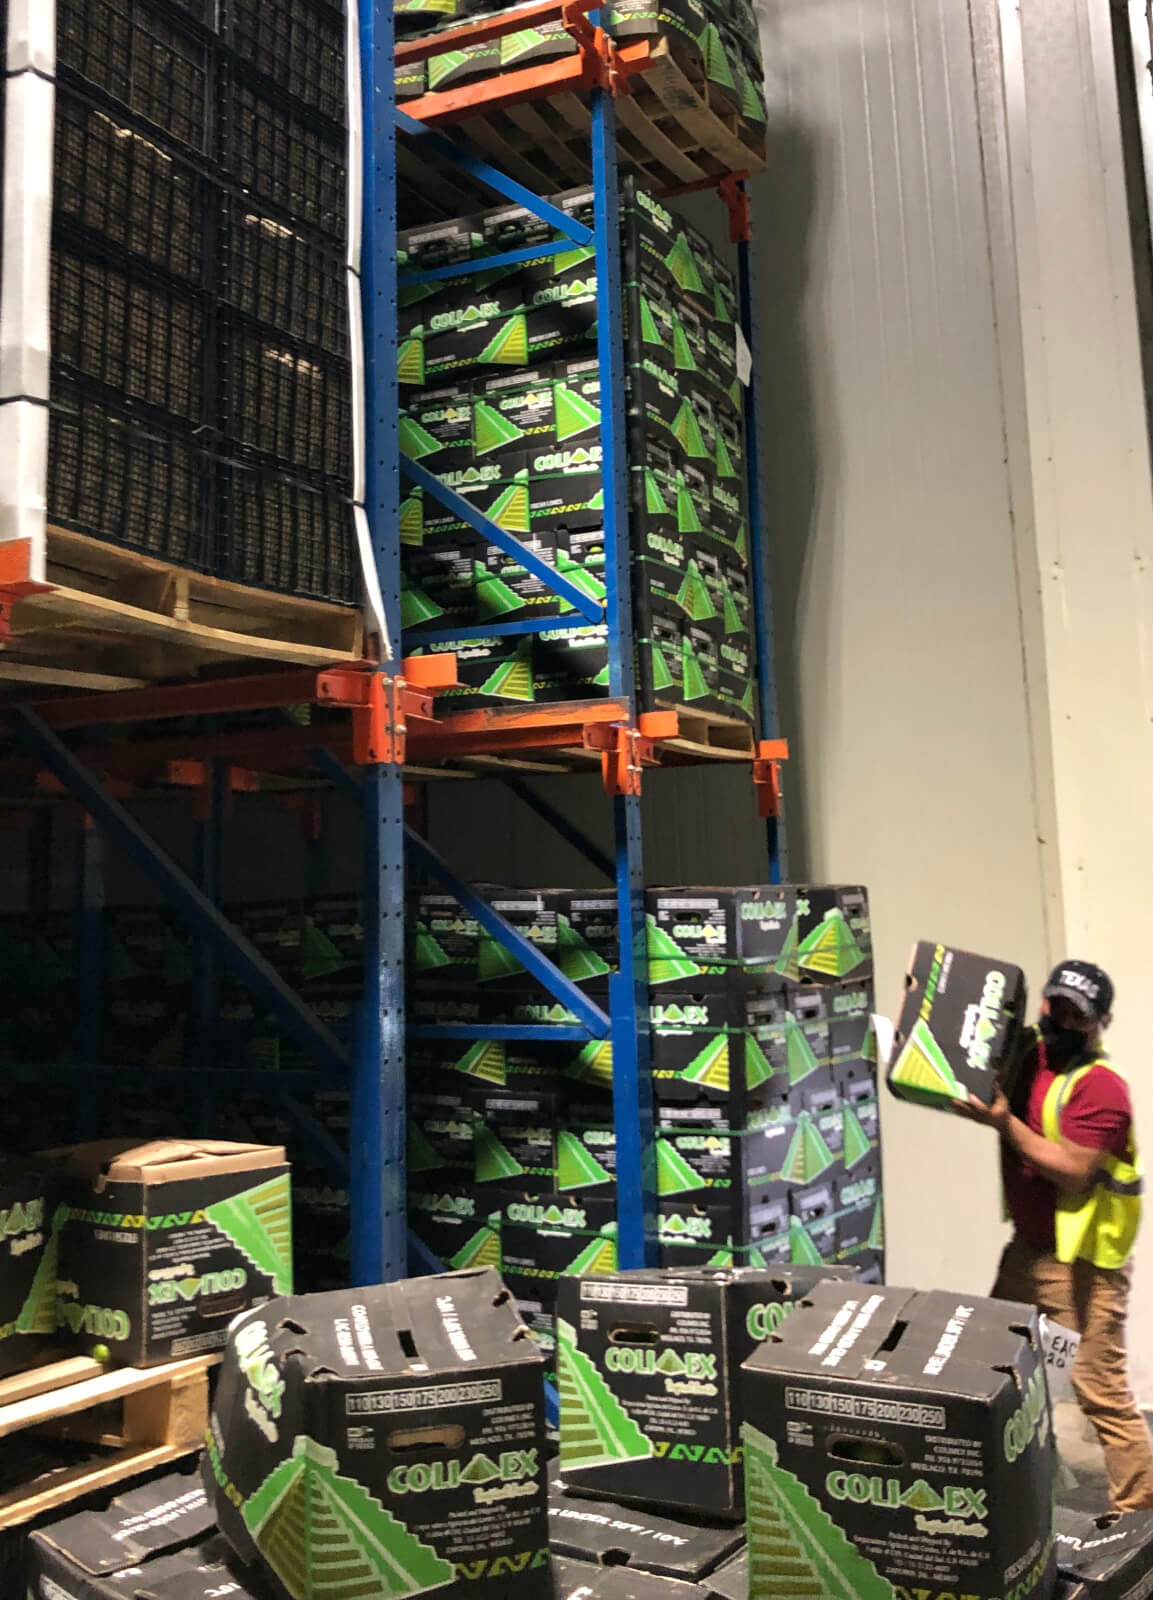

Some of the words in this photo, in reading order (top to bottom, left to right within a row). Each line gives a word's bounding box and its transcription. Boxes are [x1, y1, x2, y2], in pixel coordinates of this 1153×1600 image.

[789, 1391, 808, 1406] 110
[811, 1394, 830, 1409] 130
[832, 1397, 851, 1412] 150
[855, 1401, 875, 1416] 175
[877, 1403, 897, 1419] 200
[900, 1406, 919, 1422] 230
[921, 1409, 942, 1425] 250
